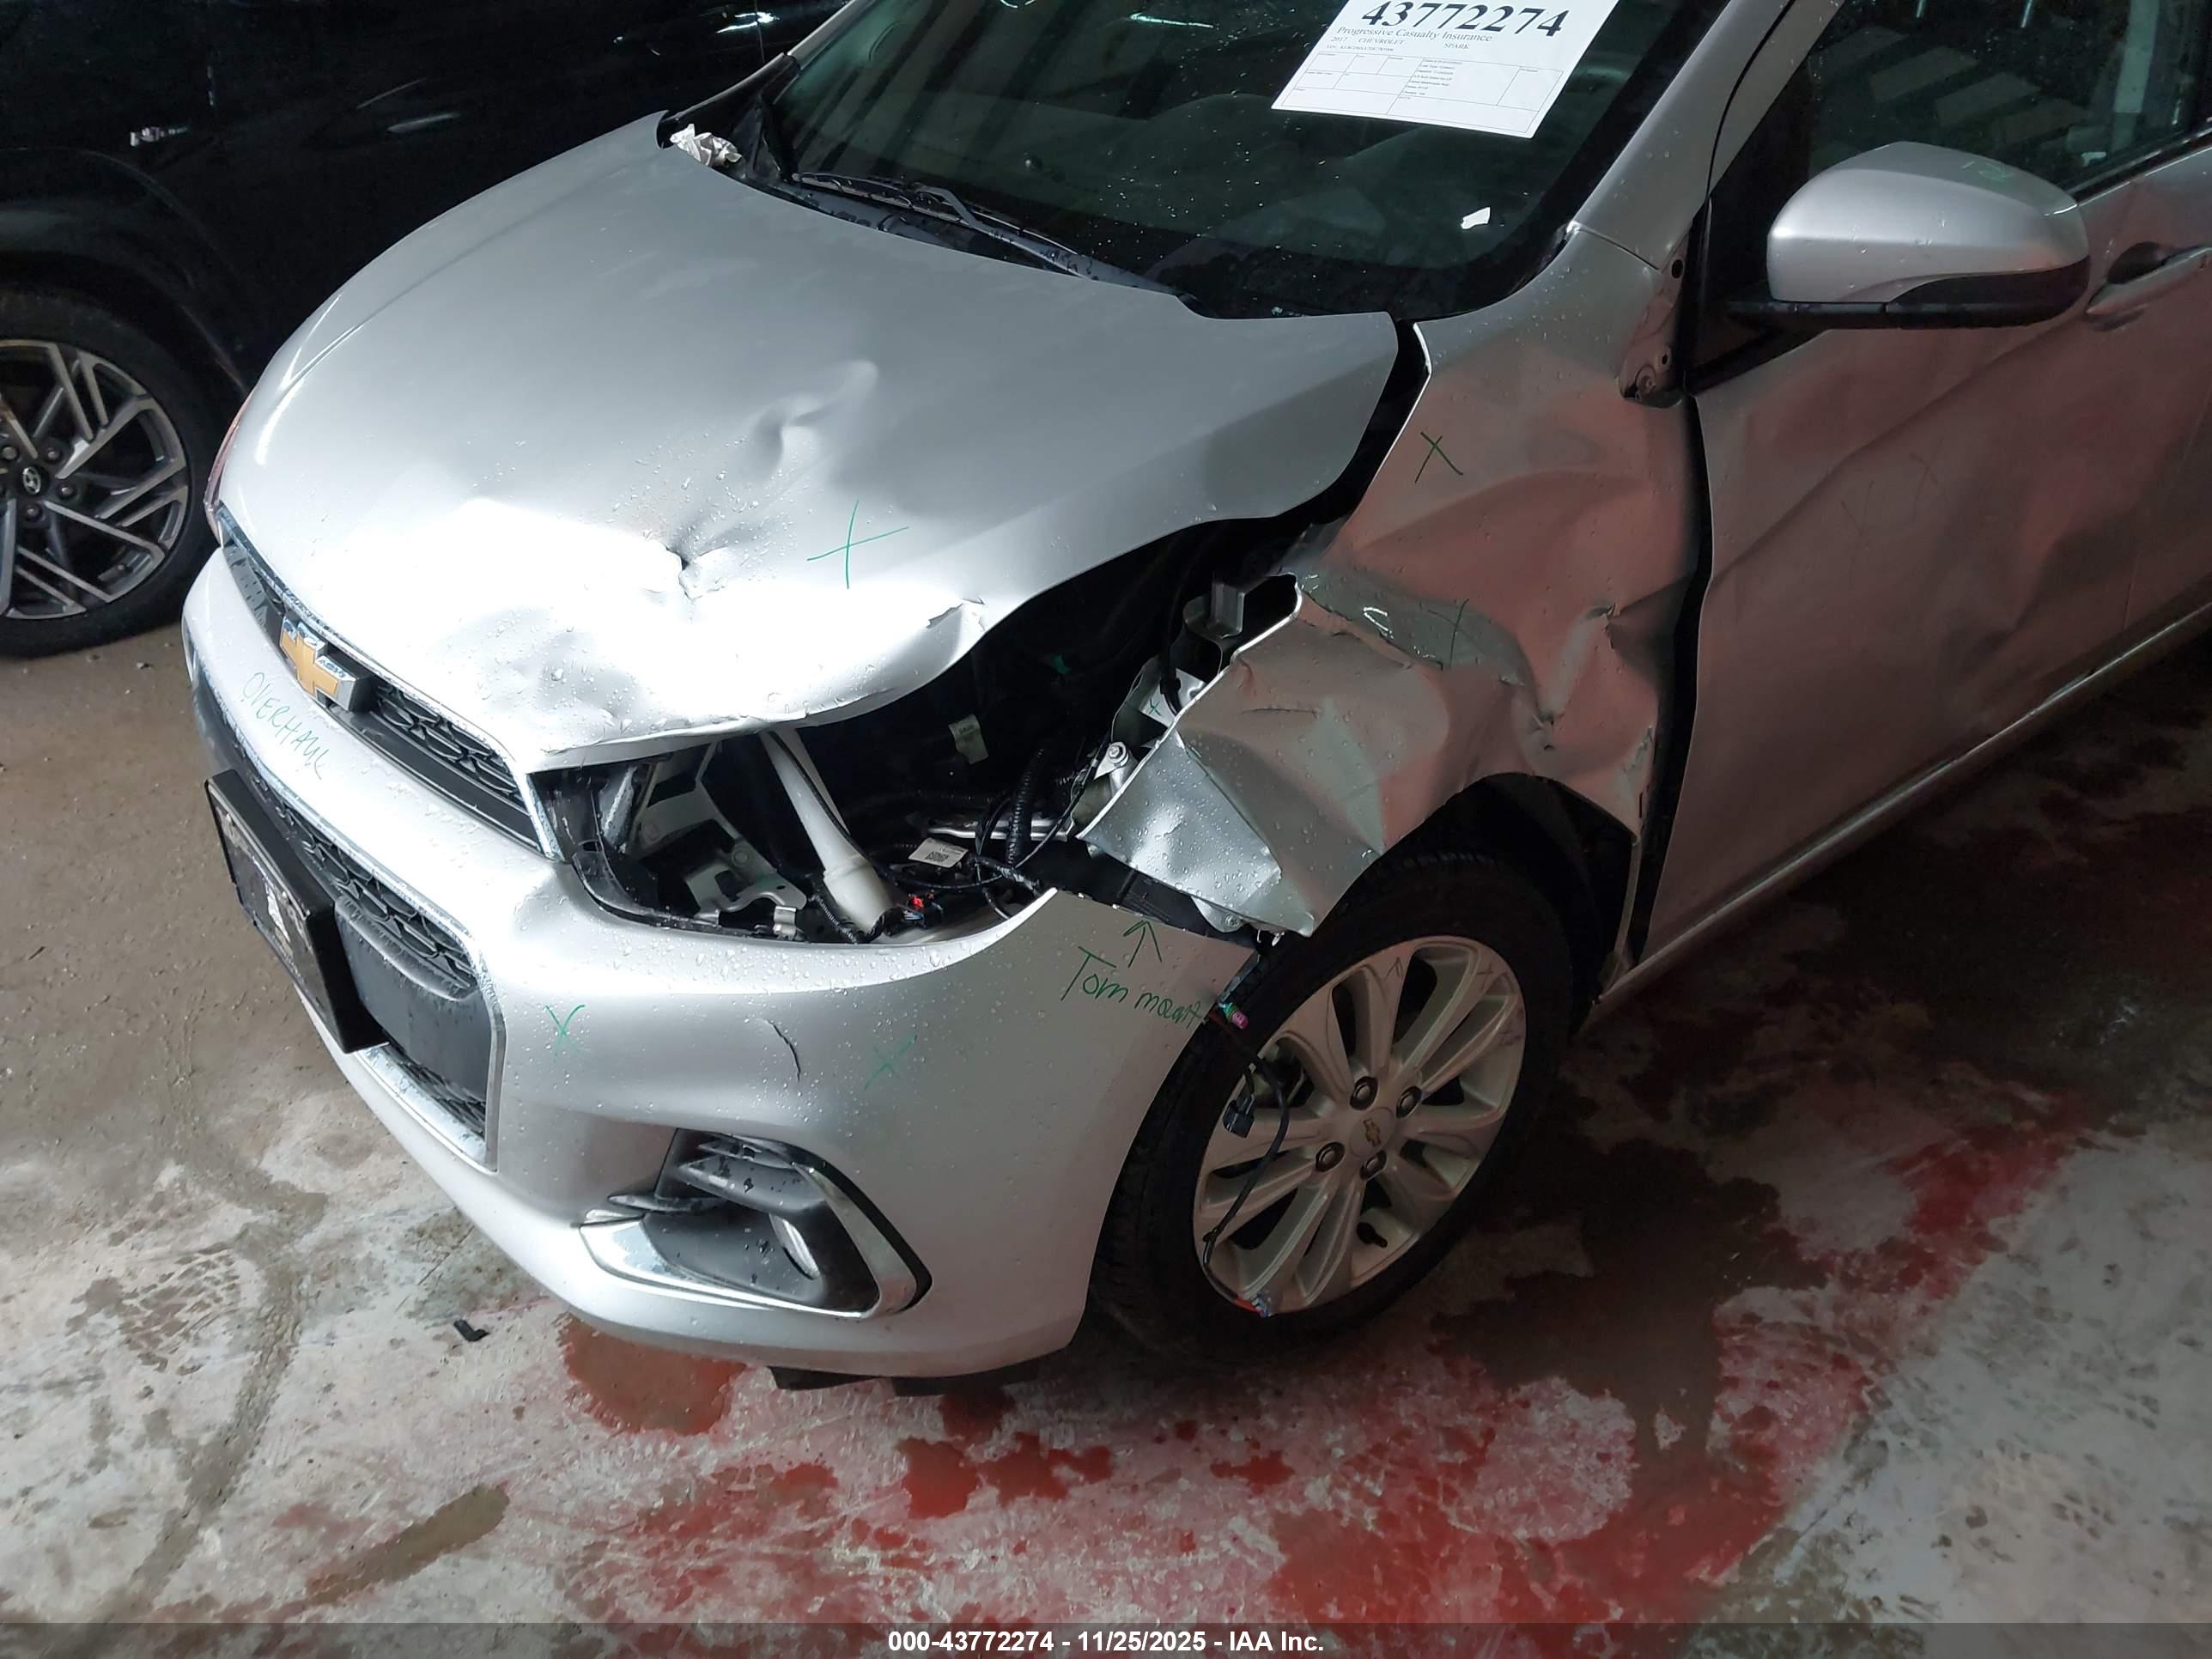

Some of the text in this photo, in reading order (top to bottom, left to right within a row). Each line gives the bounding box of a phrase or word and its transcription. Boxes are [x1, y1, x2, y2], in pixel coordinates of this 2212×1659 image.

[1337, 27, 1493, 42] Progressive Casualty Insurance
[1361, 1, 1570, 37] 43772274
[1060, 945, 1129, 1004] Torn
